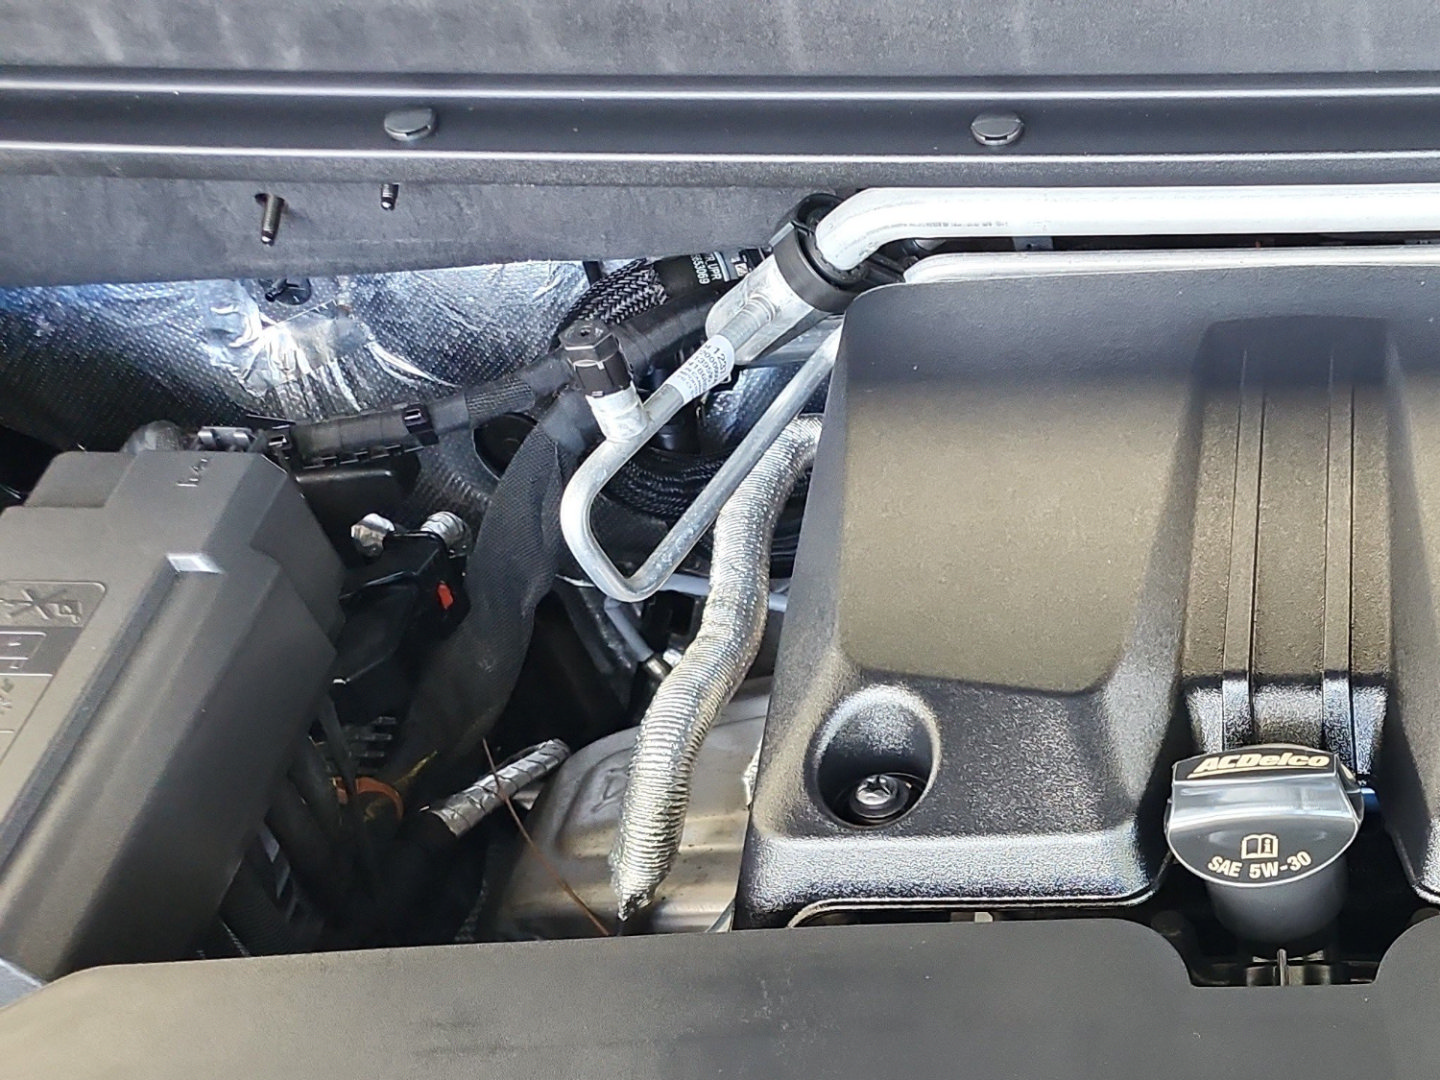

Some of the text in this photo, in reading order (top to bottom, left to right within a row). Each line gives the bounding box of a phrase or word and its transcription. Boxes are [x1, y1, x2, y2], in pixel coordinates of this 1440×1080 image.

[1192, 753, 1330, 773] ACDelco
[1207, 851, 1312, 879] SAE 5W-30
